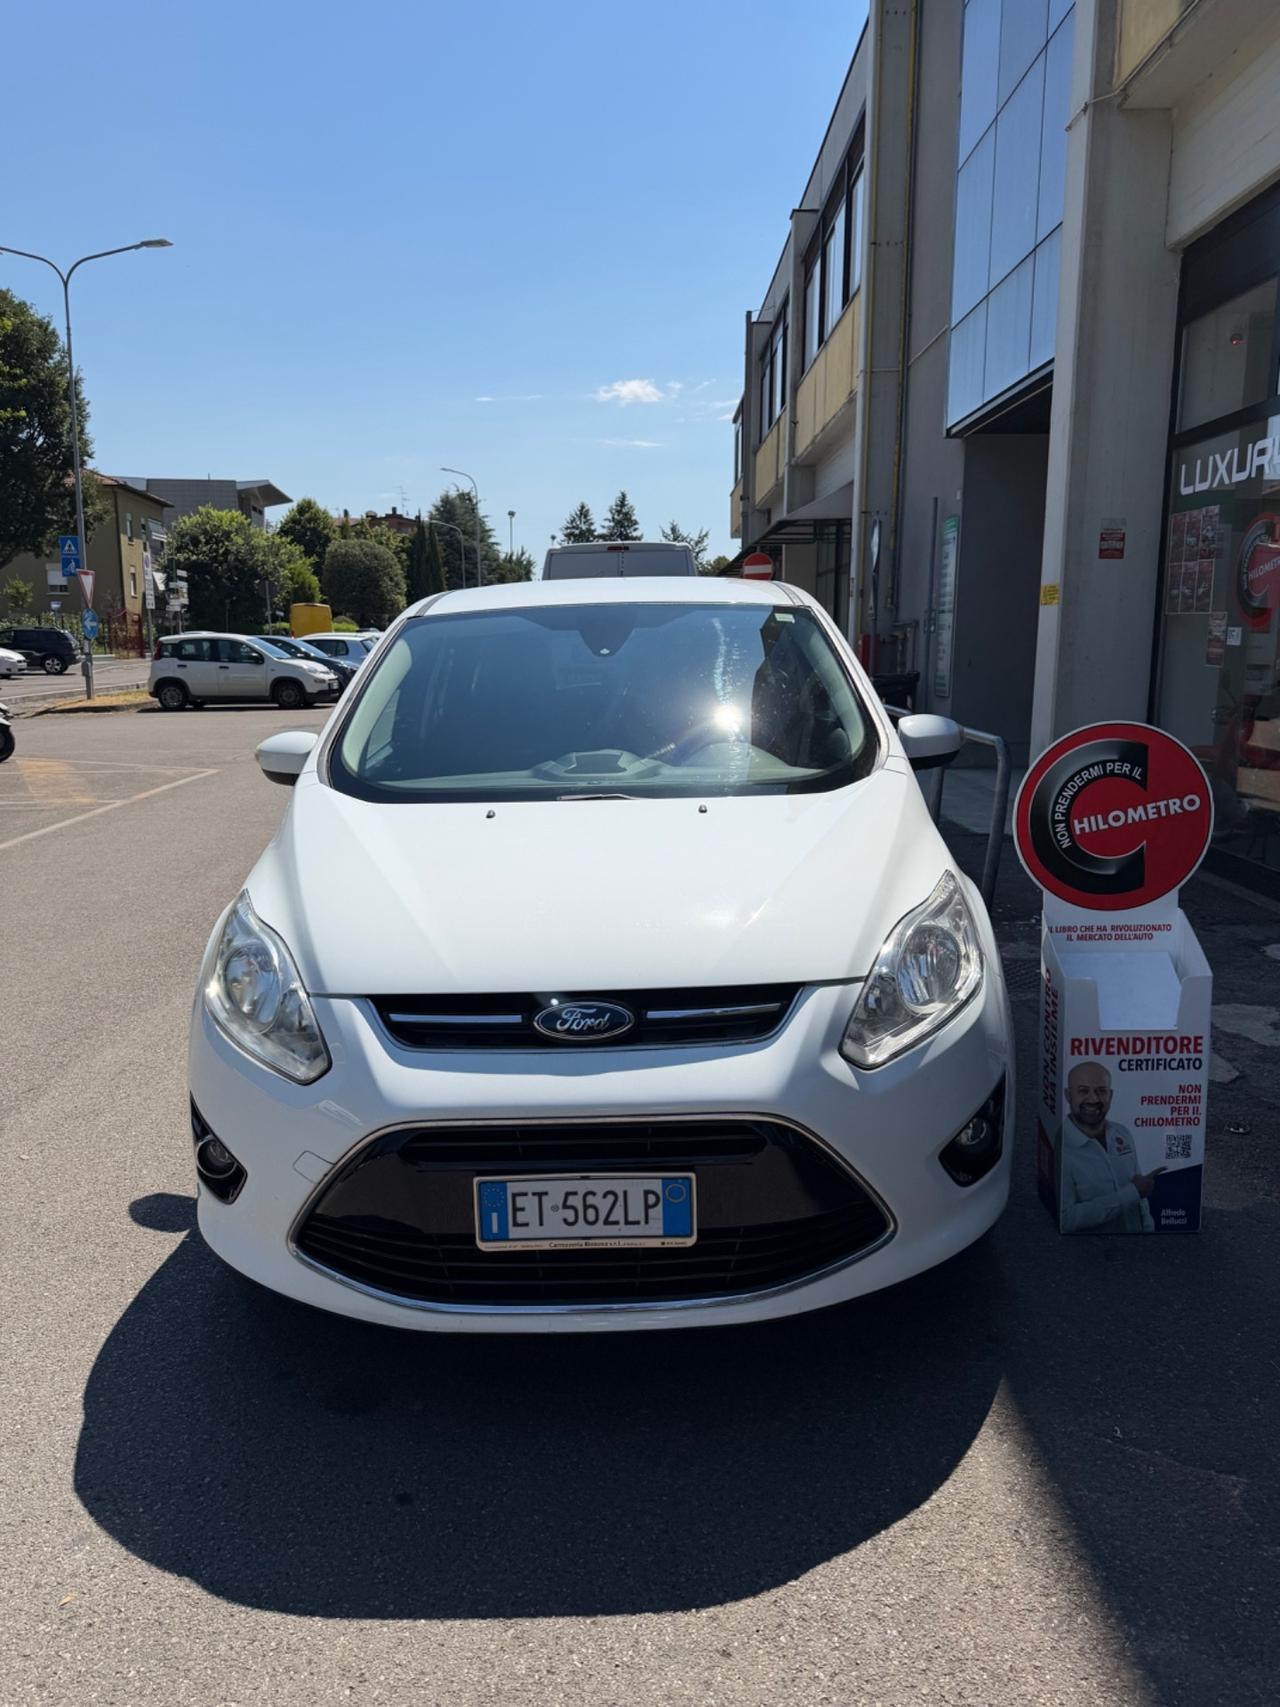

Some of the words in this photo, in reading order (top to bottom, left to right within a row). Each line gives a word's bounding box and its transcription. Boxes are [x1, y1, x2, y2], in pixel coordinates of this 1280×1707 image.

[1106, 762, 1131, 775] PER
[1132, 766, 1143, 780] IL
[1054, 764, 1105, 821] PRENDERMI
[1054, 823, 1072, 849] NON
[1056, 925, 1078, 933] LIBRO
[1080, 925, 1094, 933] CHE
[1110, 924, 1172, 933] RIVOLUZIONATO
[1066, 933, 1073, 941] IL
[1076, 933, 1113, 941] MERCATO
[1114, 932, 1154, 941] DELL'AUTO
[556, 1007, 611, 1031] Ford
[1070, 1036, 1203, 1056] RIVENDITORE
[1118, 1057, 1203, 1072] CERTIFICATO
[1178, 1084, 1202, 1094] NON
[1140, 1095, 1202, 1105] PRENDERMI
[1170, 1106, 1190, 1116] PER
[1134, 1117, 1201, 1128] CHILOMETRO
[511, 1191, 548, 1228] ET
[561, 1189, 661, 1227] 562LP
